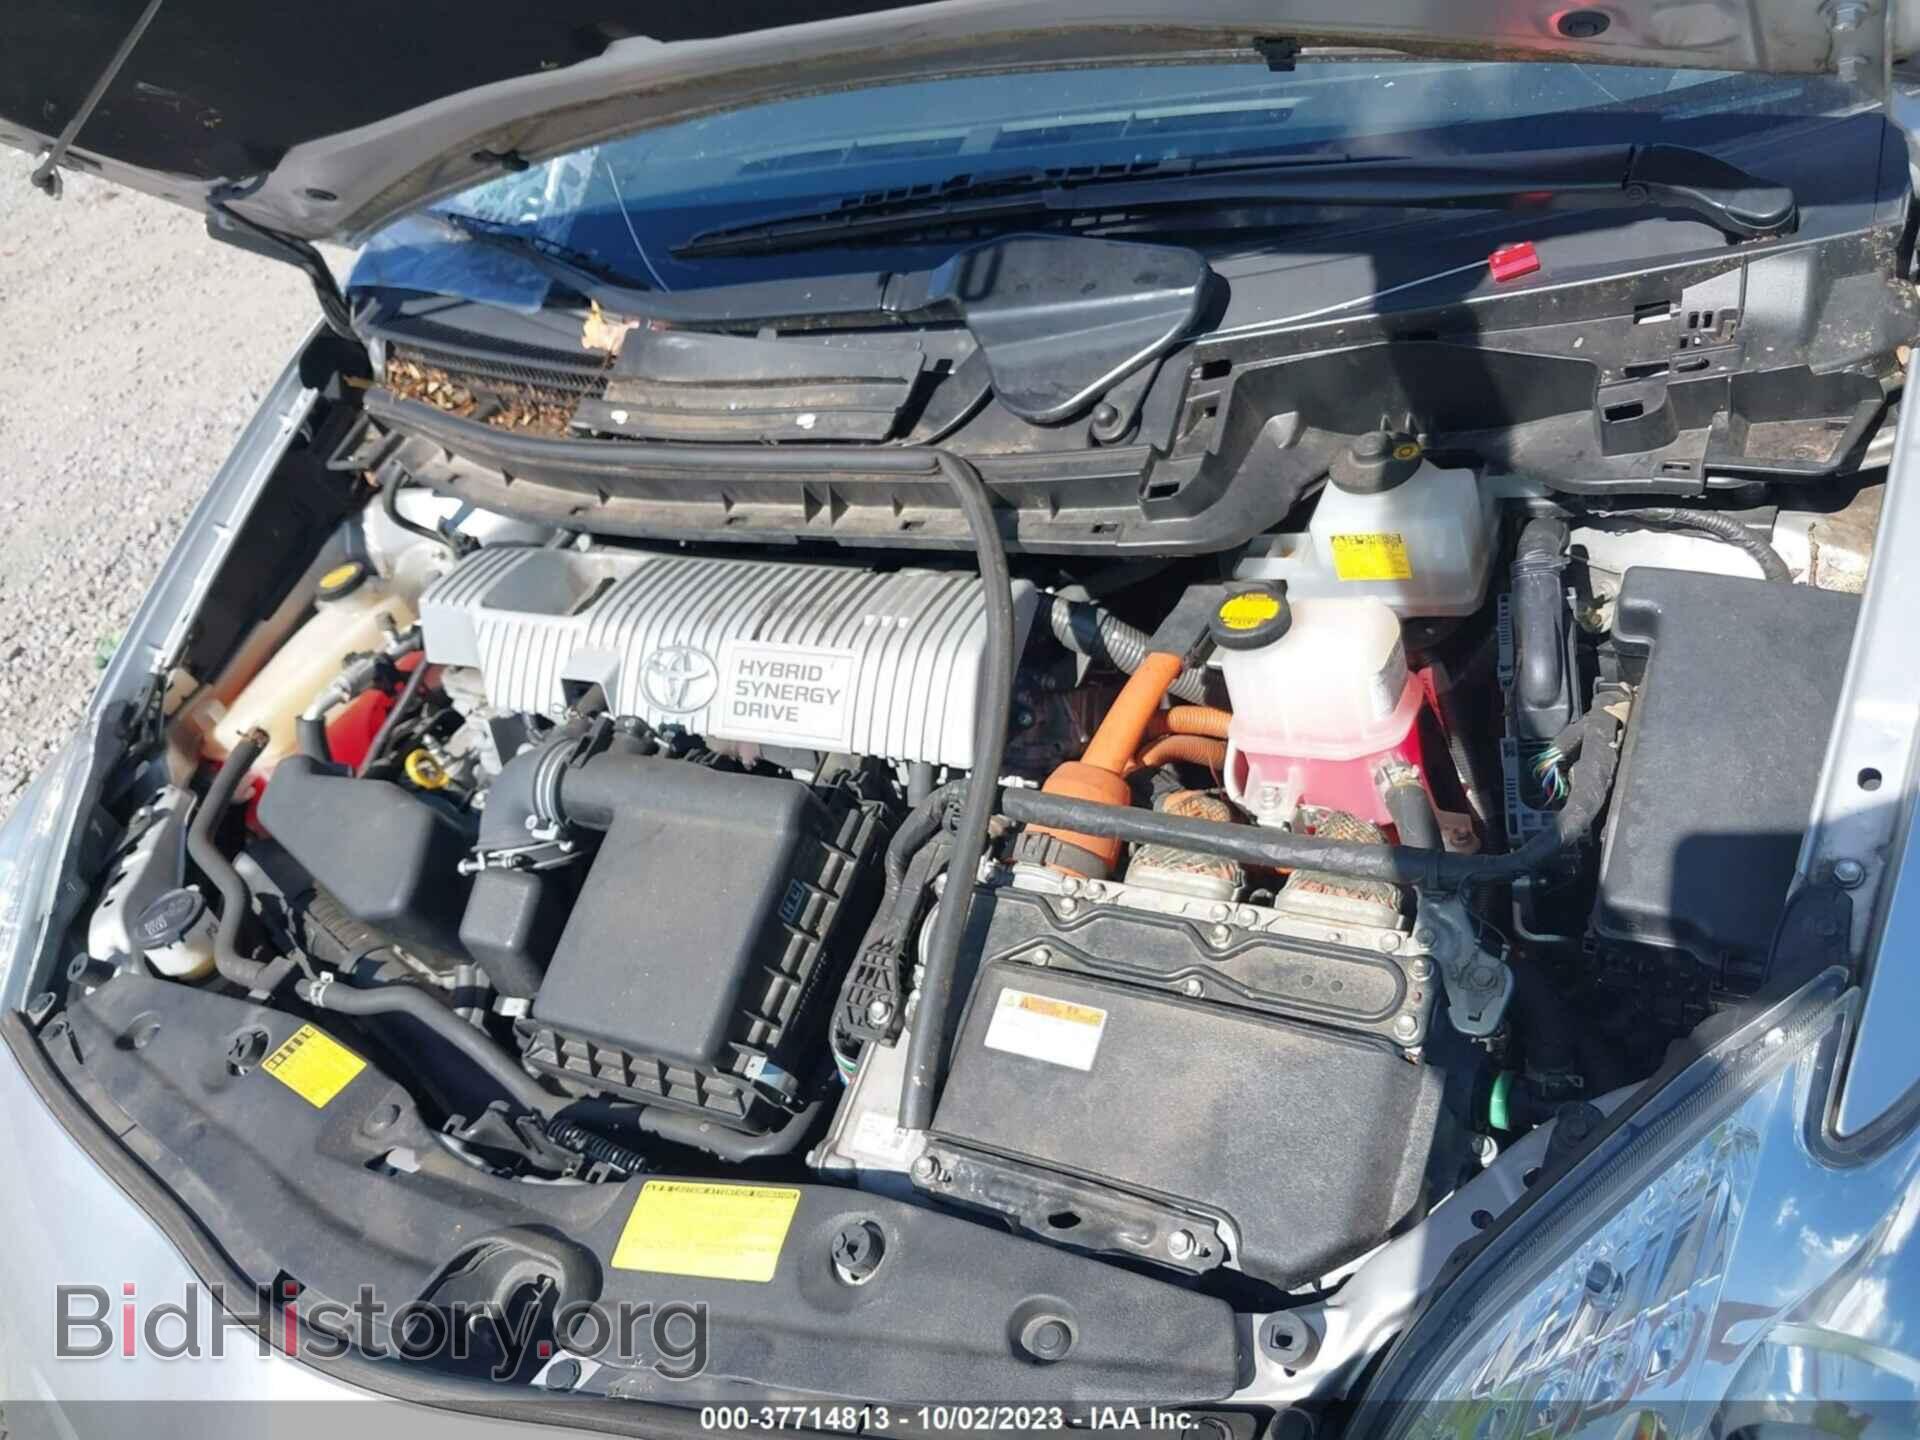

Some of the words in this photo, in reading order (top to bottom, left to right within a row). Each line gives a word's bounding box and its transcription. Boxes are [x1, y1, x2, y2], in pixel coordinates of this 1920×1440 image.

[739, 660, 823, 681] HYBRID
[736, 682, 840, 704] SYNERGY
[734, 701, 798, 722] DRIVE
